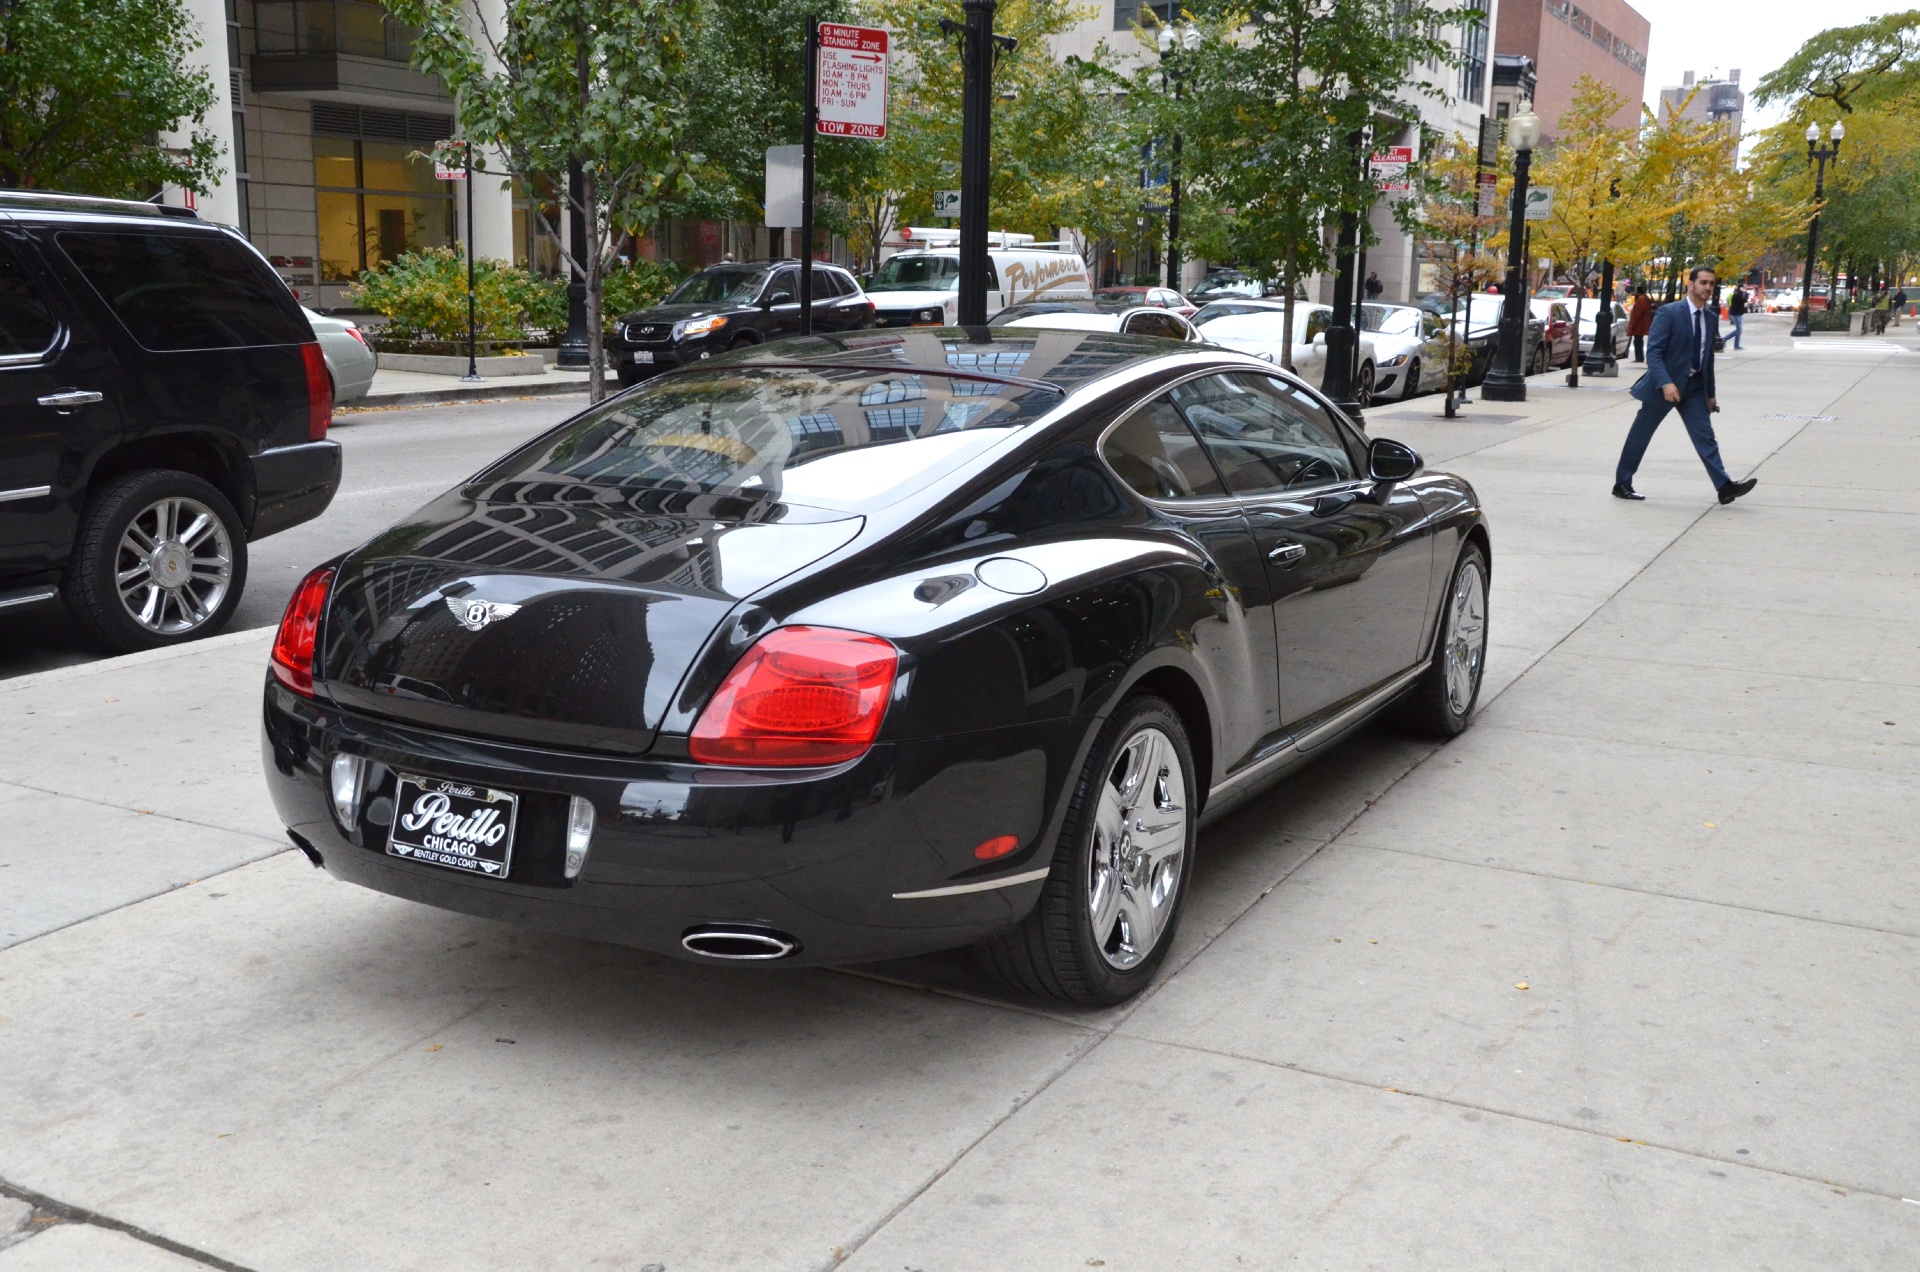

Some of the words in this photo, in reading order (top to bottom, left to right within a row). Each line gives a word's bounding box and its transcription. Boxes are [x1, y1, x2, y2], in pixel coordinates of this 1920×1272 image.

[823, 26, 831, 35] 15
[833, 28, 860, 39] MINUTE
[823, 36, 858, 48] STANDING
[861, 40, 880, 51] ZONE
[823, 51, 837, 60] USE
[822, 61, 858, 72] FLASHING
[859, 64, 883, 75] LIGHTS
[822, 69, 831, 78] 10
[832, 71, 843, 79] AM
[850, 72, 855, 80] 8
[857, 73, 868, 81] PM
[822, 79, 838, 88] MON
[847, 81, 871, 91] THURS
[822, 88, 830, 96] 10
[831, 89, 842, 98] AM
[849, 91, 855, 99] 6
[821, 97, 834, 106] FRI
[841, 99, 856, 108] SUN
[821, 121, 845, 134] TOW
[850, 125, 880, 137] ZONE
[1005, 258, 1081, 306] Performers
[467, 605, 485, 622] B
[437, 781, 475, 797] Perillo
[401, 792, 506, 846] Perillo
[423, 834, 477, 857] CHICAGO
[413, 848, 439, 861] BENTLEY
[439, 853, 457, 865] GOLD
[457, 856, 478, 870] COAST
